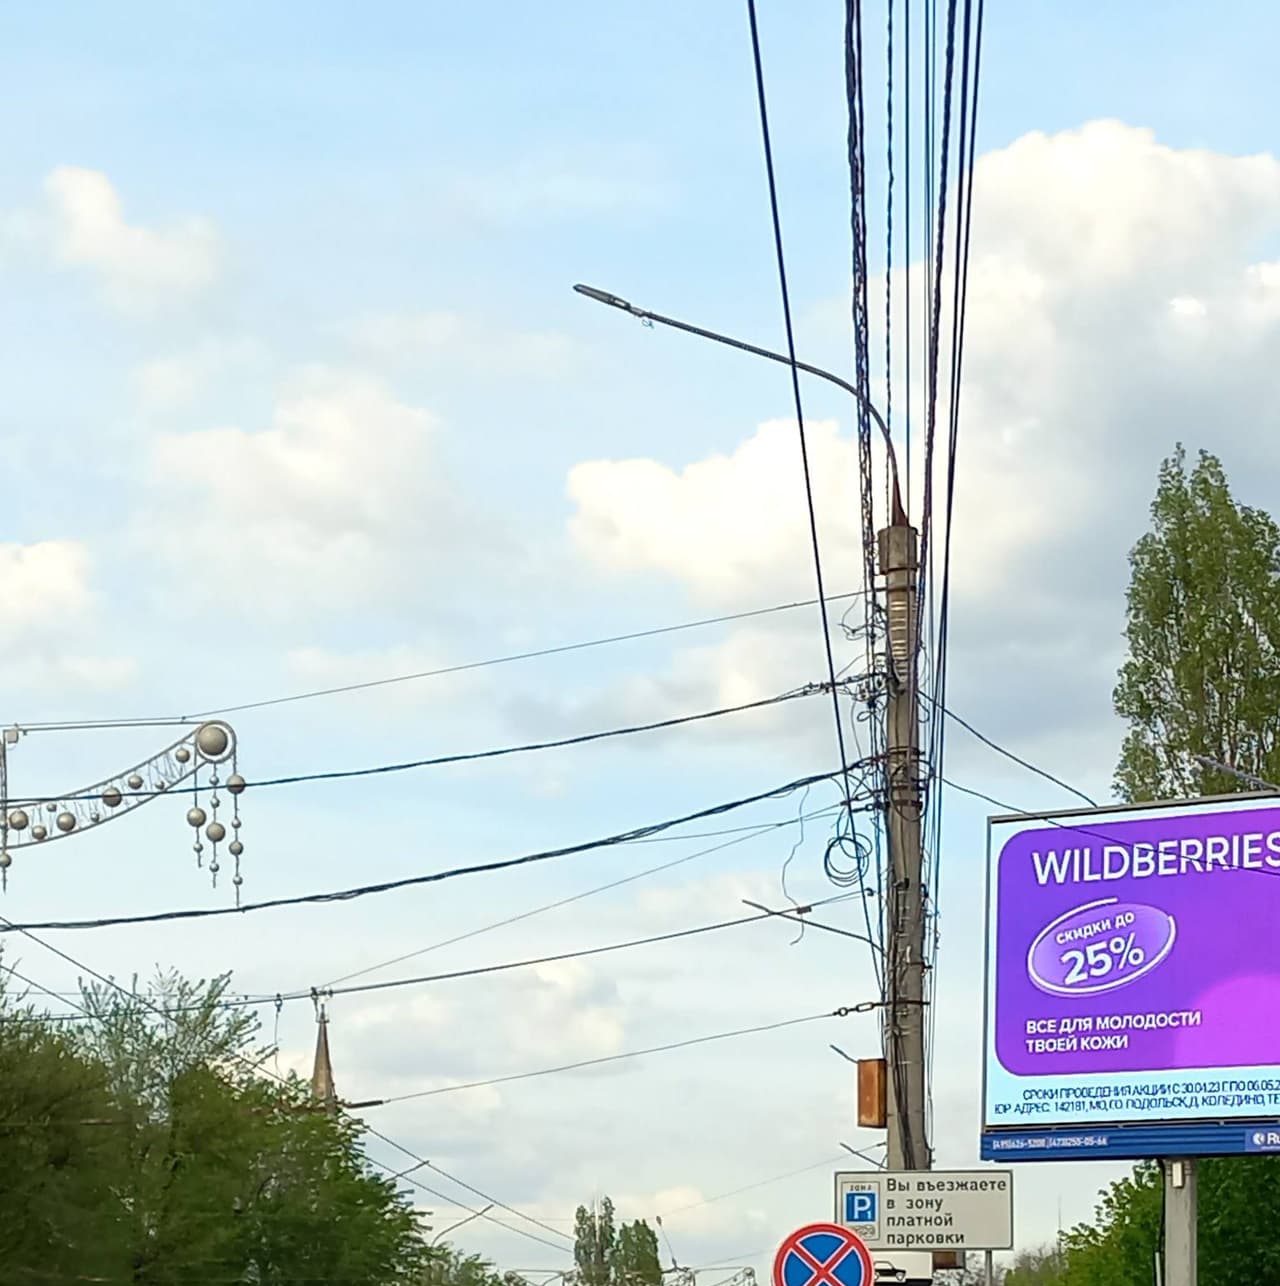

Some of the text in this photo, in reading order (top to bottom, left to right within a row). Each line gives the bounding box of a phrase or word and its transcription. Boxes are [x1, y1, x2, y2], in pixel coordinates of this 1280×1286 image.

[1061, 932, 1144, 985] 25%
[1026, 1011, 1201, 1034] ВСЕ ДЛЯ МОЛОДОСТИ
[1026, 1035, 1128, 1053] ТВОЕЙ КОЖИ
[1023, 1088, 1058, 1100] СРОКИ
[1172, 1082, 1180, 1094] С
[887, 1179, 1007, 1191] Вы въезжаете
[887, 1199, 943, 1212] в зону
[887, 1213, 953, 1227] платной
[887, 1233, 965, 1247] парковки
